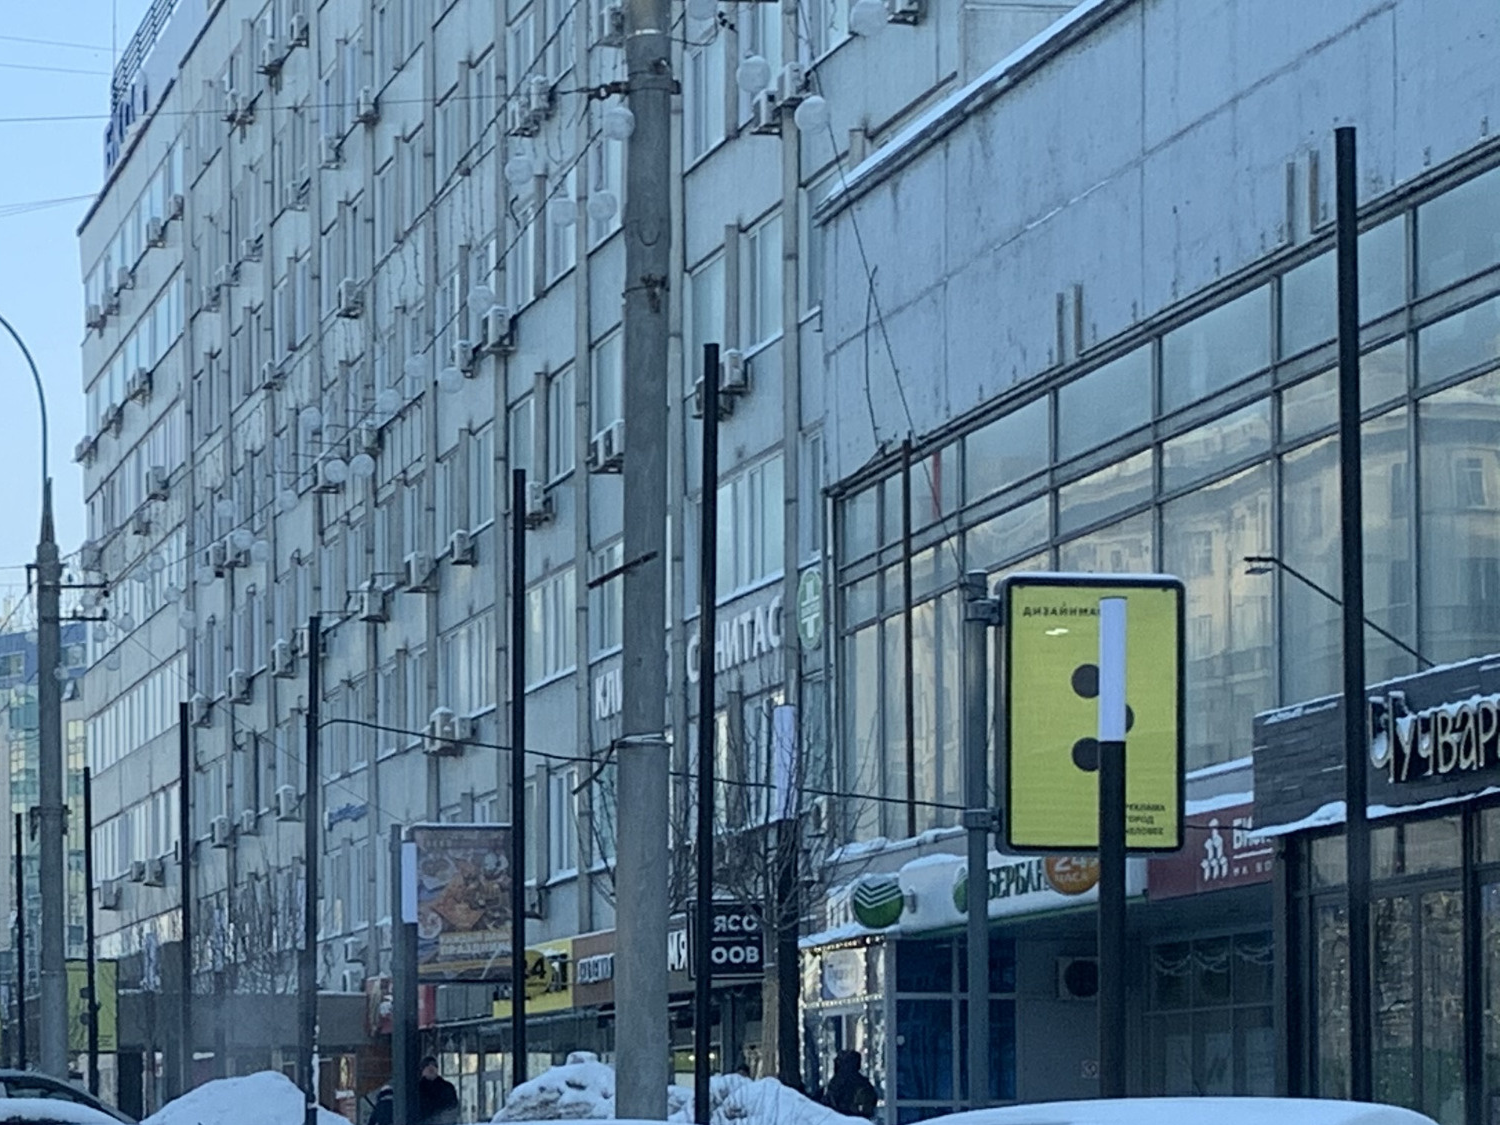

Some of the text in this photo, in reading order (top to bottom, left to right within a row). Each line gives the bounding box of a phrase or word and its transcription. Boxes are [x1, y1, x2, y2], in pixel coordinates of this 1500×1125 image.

[1023, 601, 1100, 617] ДИЗАЙНМА
[686, 595, 785, 684] СНИТАС
[1127, 815, 1154, 825] ОРОД
[987, 858, 1050, 900] БЕРБАН
[713, 914, 758, 933] ЯСО
[711, 946, 760, 964] ООВ
